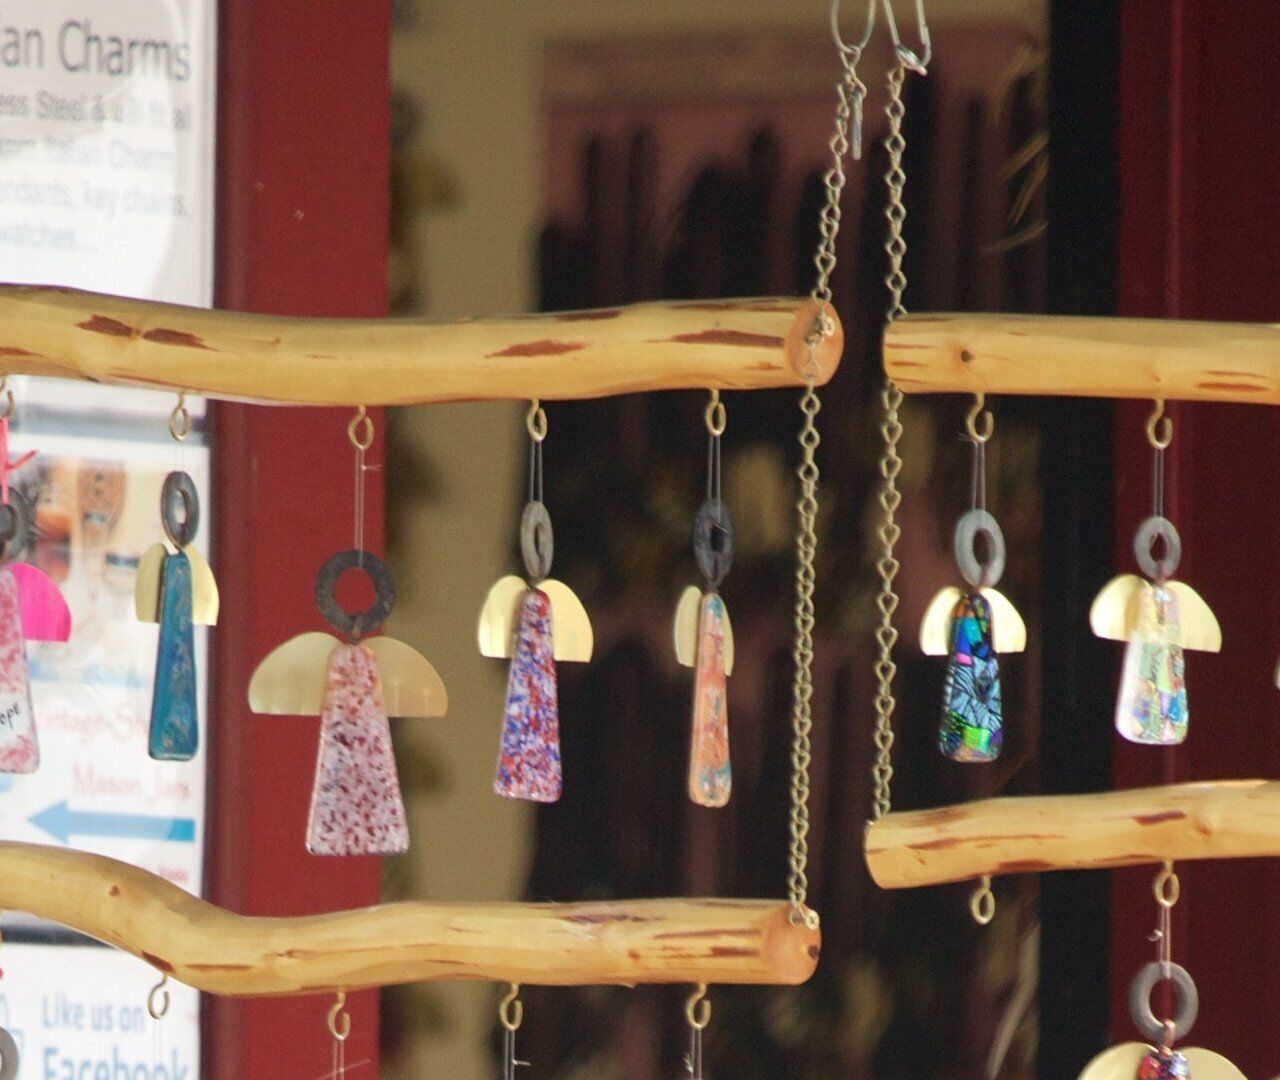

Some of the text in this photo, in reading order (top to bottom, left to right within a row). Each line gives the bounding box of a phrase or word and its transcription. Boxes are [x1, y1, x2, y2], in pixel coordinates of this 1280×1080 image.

[57, 18, 191, 82] Charms
[35, 88, 87, 122] Steel
[42, 992, 145, 1032] Like us on
